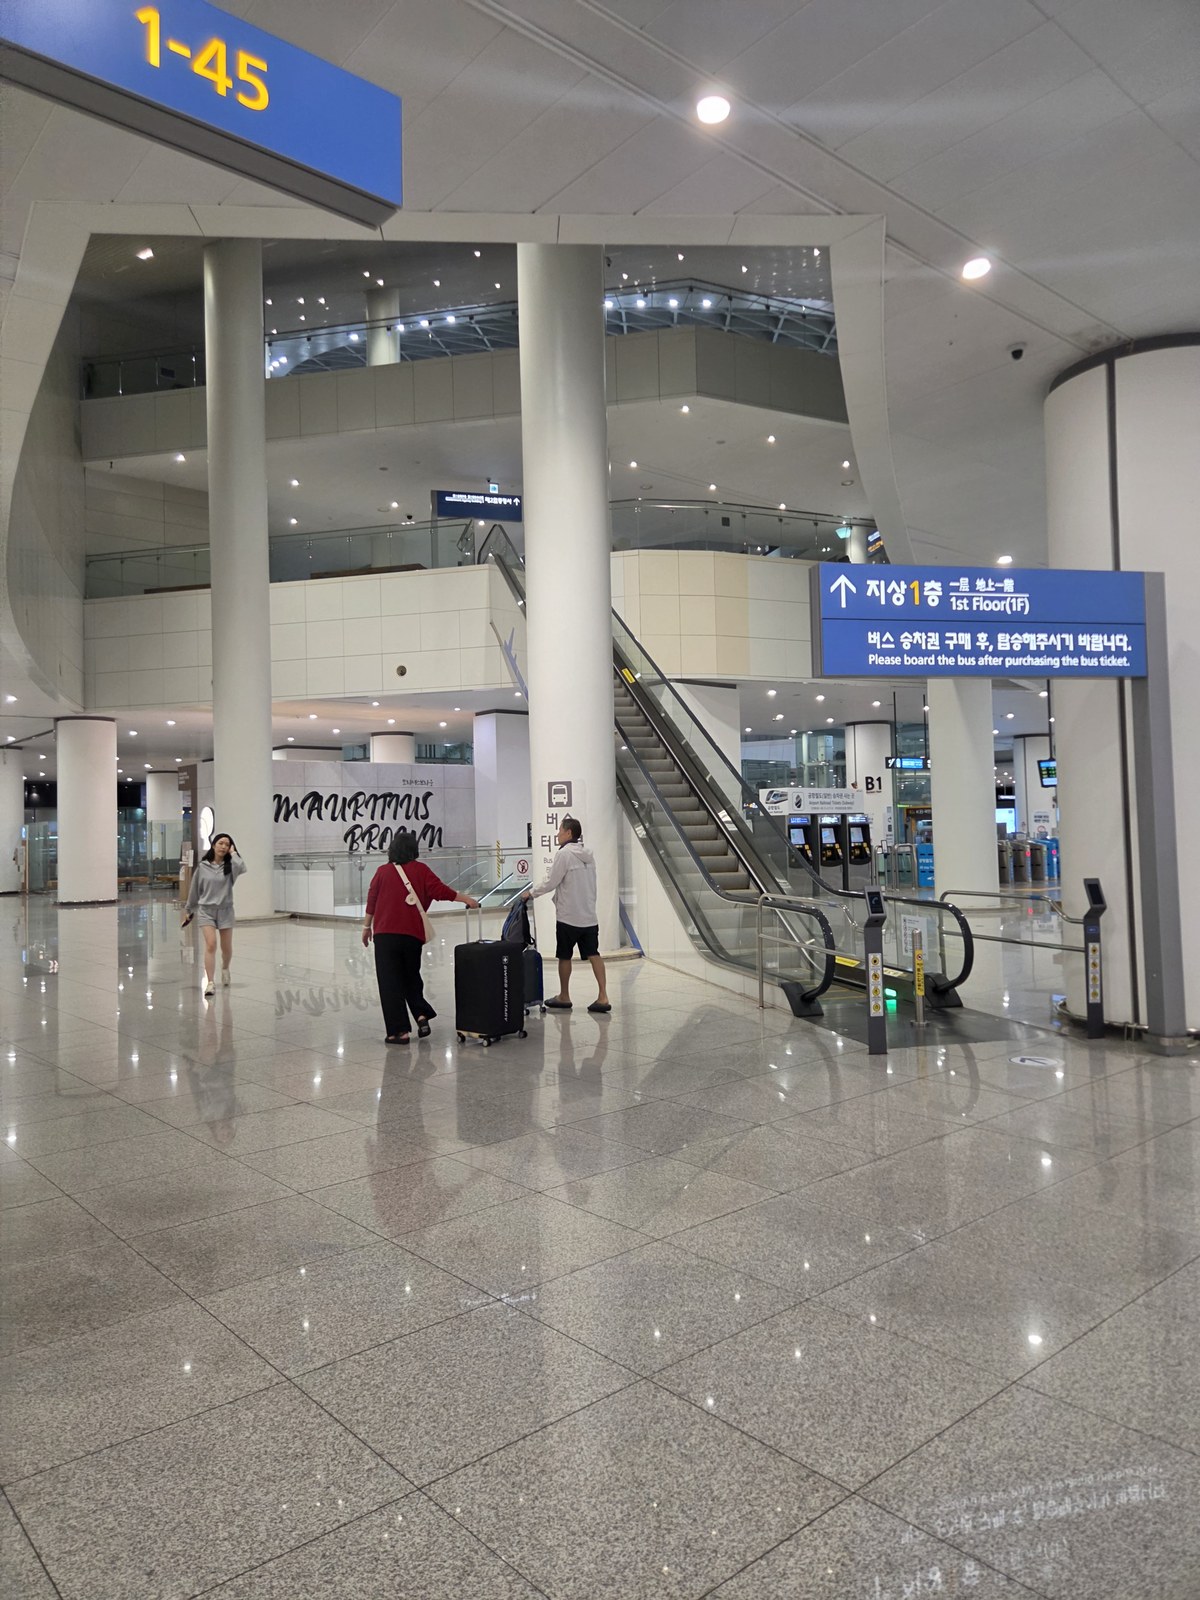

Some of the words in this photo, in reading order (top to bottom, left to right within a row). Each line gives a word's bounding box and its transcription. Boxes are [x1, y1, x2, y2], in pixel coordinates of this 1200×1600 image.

[134, 5, 269, 111] 1-45
[866, 579, 943, 607] 지상1층
[950, 596, 969, 611] 1st
[972, 596, 1030, 615] Floor(1F)
[867, 631, 895, 649] 버스
[900, 631, 940, 650] 승차권
[945, 632, 971, 650] 구매
[976, 631, 994, 652] 후,
[997, 632, 1074, 651] 탑승해주시기
[1078, 633, 1132, 652] 바랍니다.
[868, 653, 901, 665] Please
[904, 653, 935, 666] board
[937, 654, 956, 666] the
[958, 654, 976, 666] bus
[977, 654, 1004, 666] after
[1005, 654, 1060, 669] purchasing
[1061, 655, 1079, 667] the
[1080, 655, 1099, 667] bus
[1099, 655, 1131, 667] ticket.
[865, 776, 882, 791] B1
[273, 791, 433, 822] MAURITIUS
